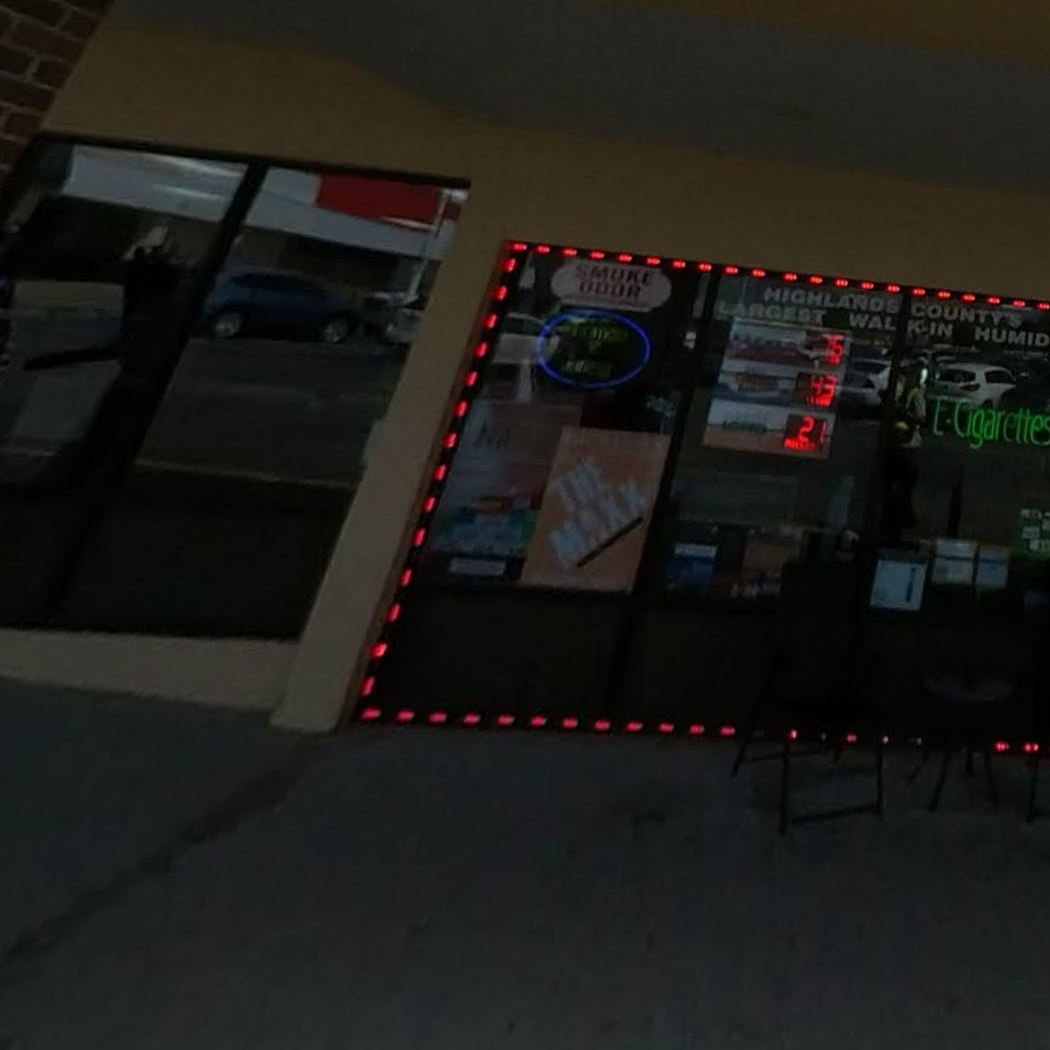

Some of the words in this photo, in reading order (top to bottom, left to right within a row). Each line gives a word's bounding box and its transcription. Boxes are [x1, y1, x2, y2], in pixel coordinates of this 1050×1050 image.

[714, 298, 828, 327] LARGEST
[764, 287, 901, 314] HIGHLANDS
[910, 302, 1024, 329] COUNTY'S
